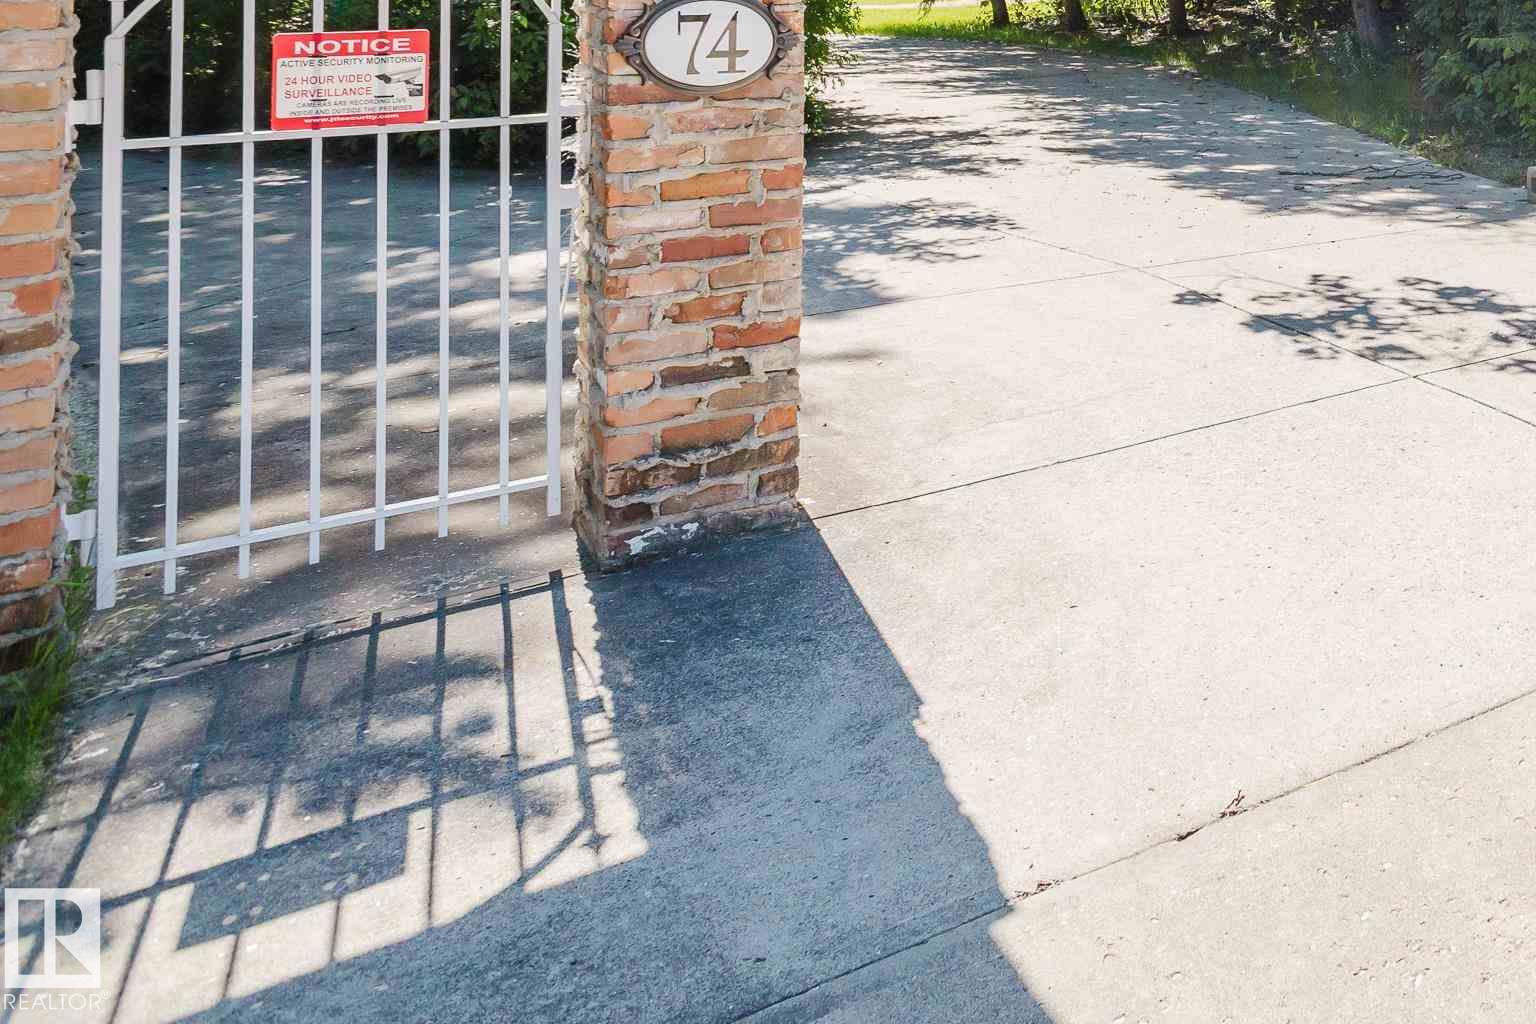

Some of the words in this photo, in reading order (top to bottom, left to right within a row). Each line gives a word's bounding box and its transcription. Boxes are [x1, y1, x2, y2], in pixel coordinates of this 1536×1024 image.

[294, 37, 412, 55] NOTICE
[677, 10, 750, 75] 74
[280, 59, 315, 68] ACTIVE
[317, 57, 364, 67] SECURITY
[366, 55, 424, 64] MONITORING
[285, 76, 298, 86] 24
[301, 75, 335, 85] HOUR
[338, 74, 373, 83] VIDEO
[284, 87, 373, 99] SURVEILLANCE
[296, 100, 332, 108] CAMERAS
[349, 98, 390, 106] RECORDING
